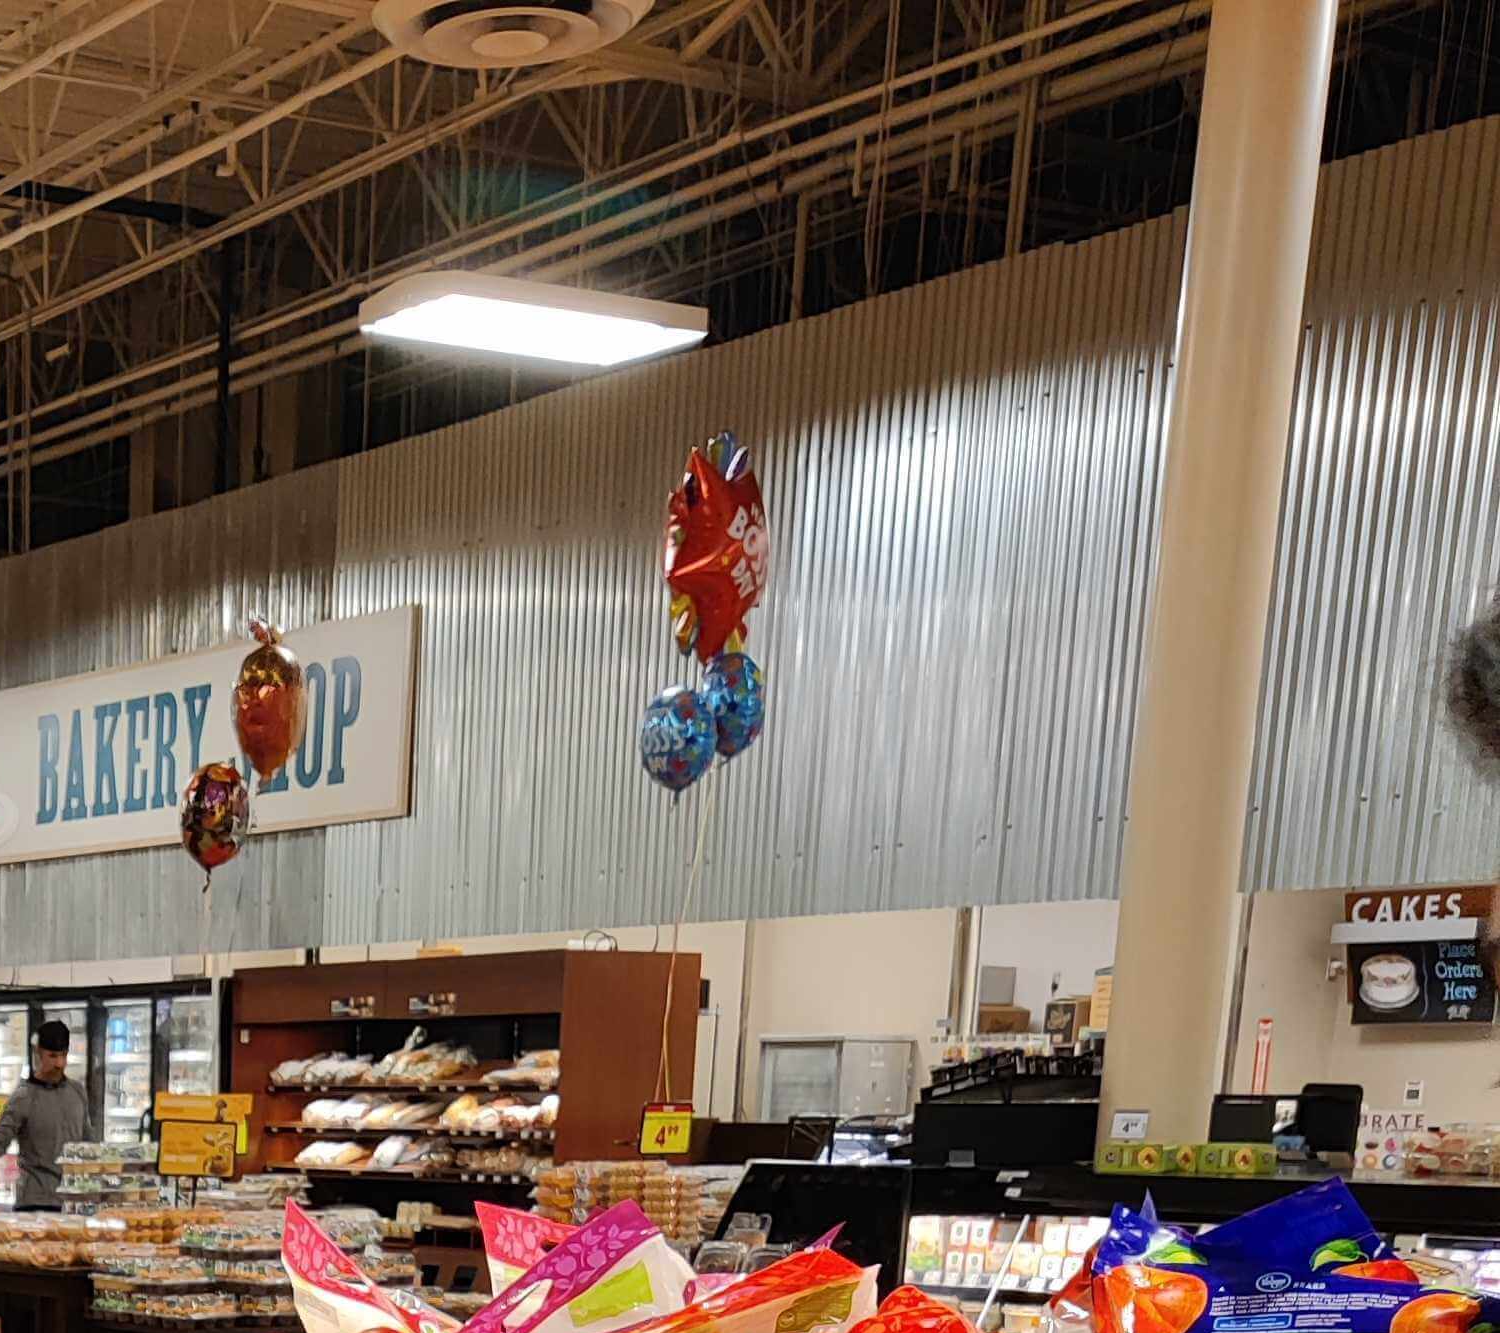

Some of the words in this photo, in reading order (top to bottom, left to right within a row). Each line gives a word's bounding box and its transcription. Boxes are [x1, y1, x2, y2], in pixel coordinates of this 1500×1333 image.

[36, 684, 211, 825] BAKERY
[231, 656, 362, 796] OP
[1350, 893, 1463, 925] CAKES
[1435, 960, 1483, 979] Orders
[1443, 981, 1477, 1001] Here
